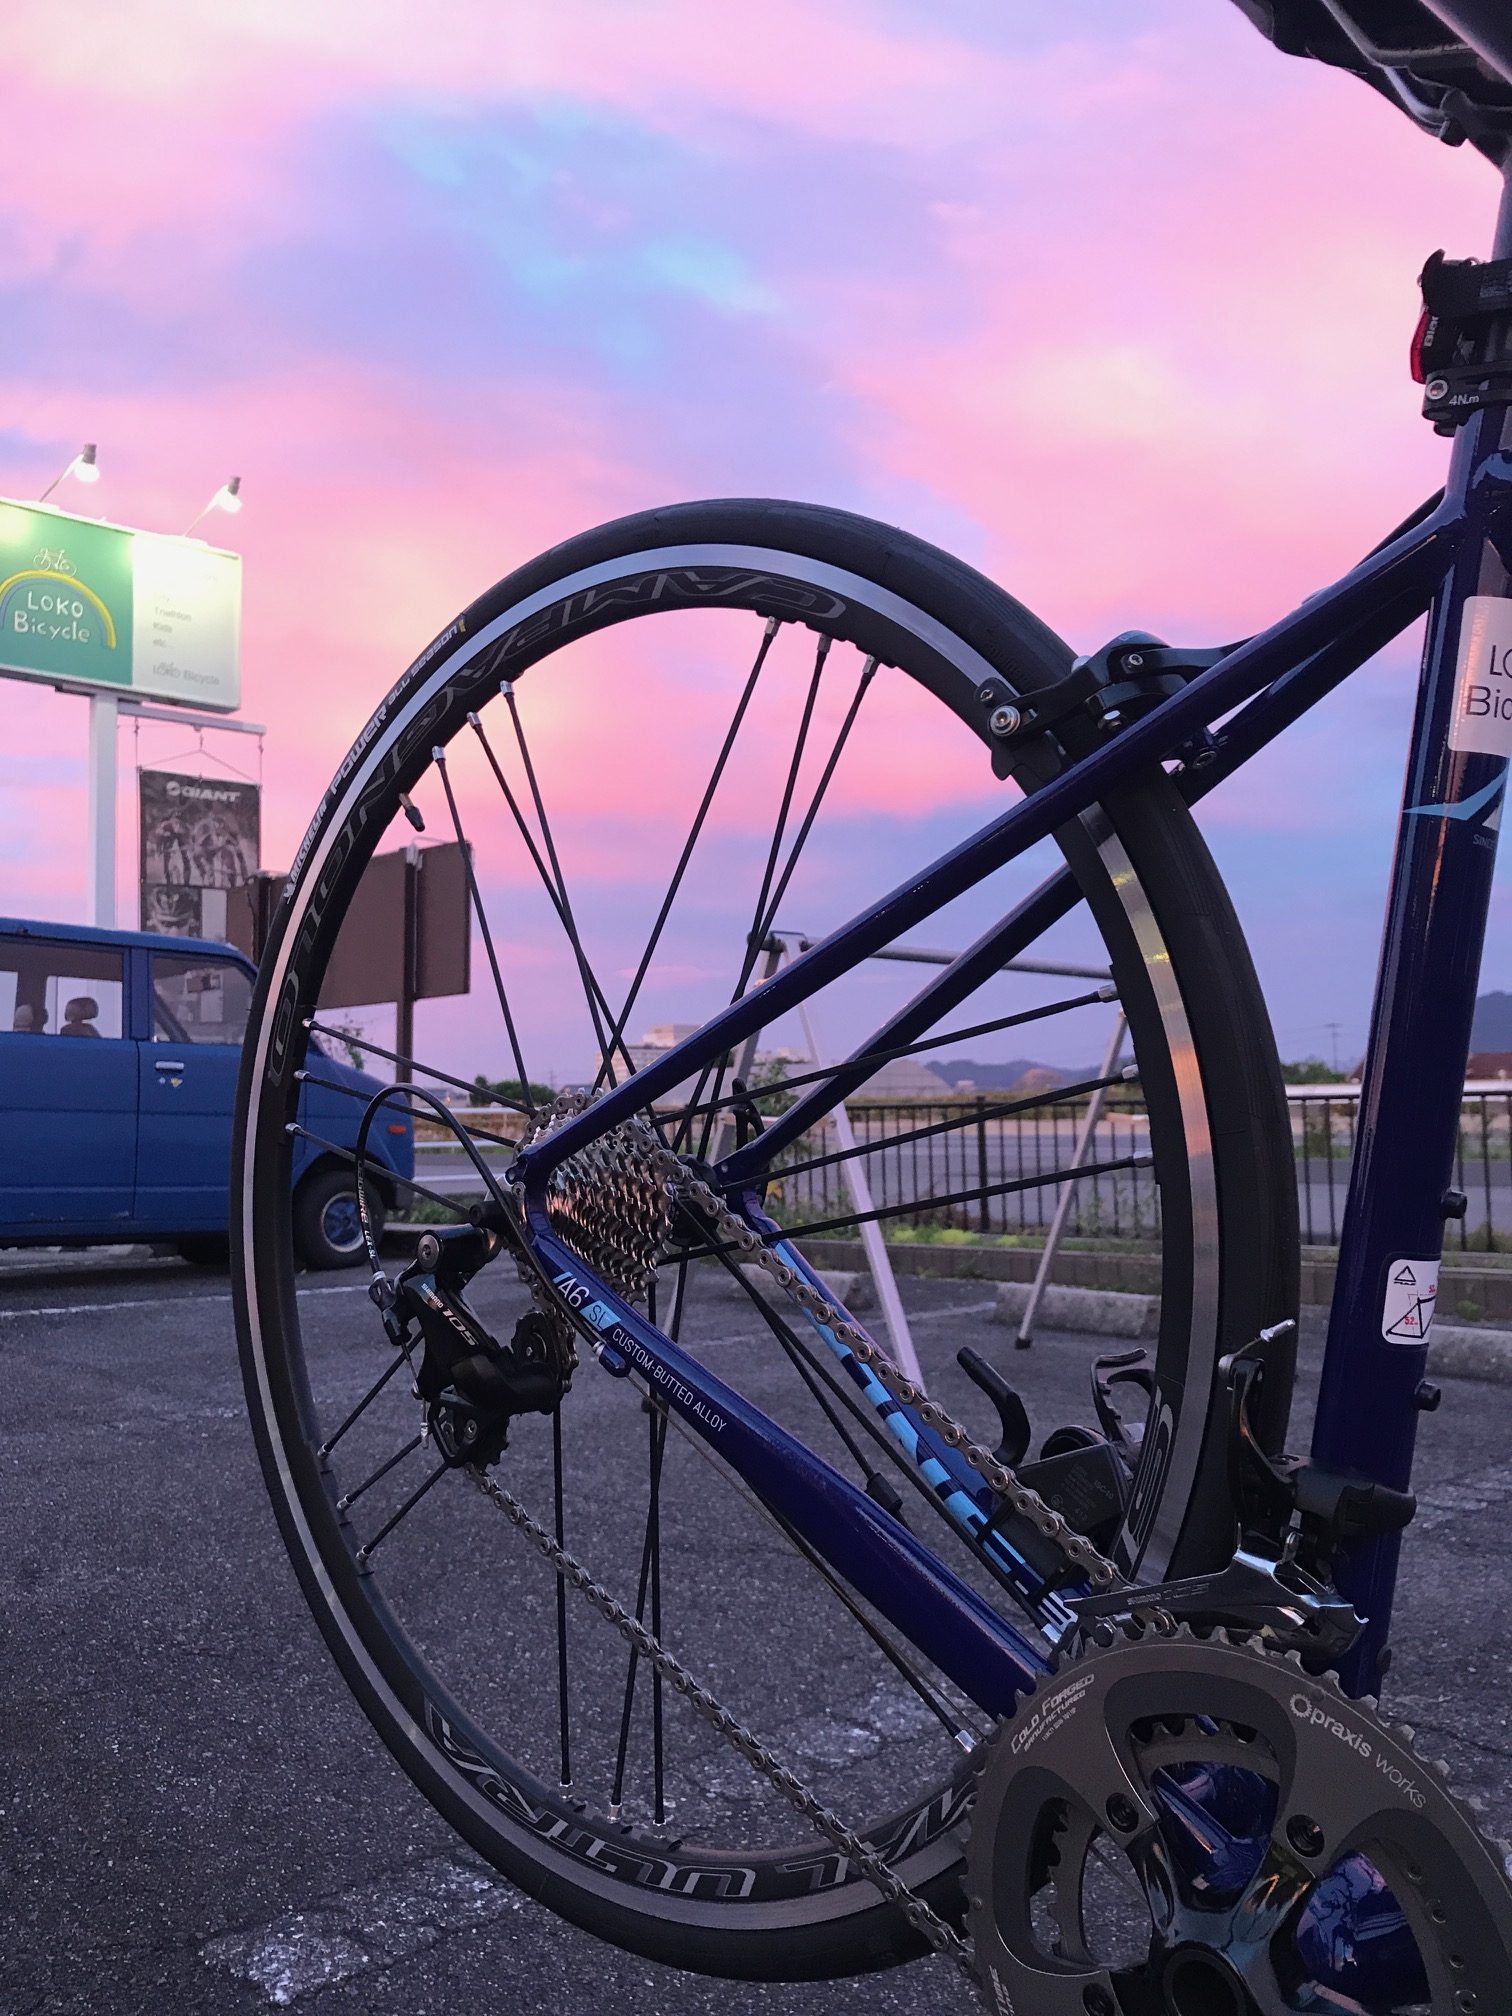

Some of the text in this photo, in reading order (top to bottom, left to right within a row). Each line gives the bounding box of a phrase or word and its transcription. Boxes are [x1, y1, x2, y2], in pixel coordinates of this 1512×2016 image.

[13, 609, 91, 643] Bicycle
[27, 590, 85, 618] LOKO
[329, 703, 389, 795] POWER
[441, 1307, 479, 1347] 105
[612, 1328, 728, 1432] CUSTOM-BUTTED ALLOY
[1374, 1751, 1427, 1810] works
